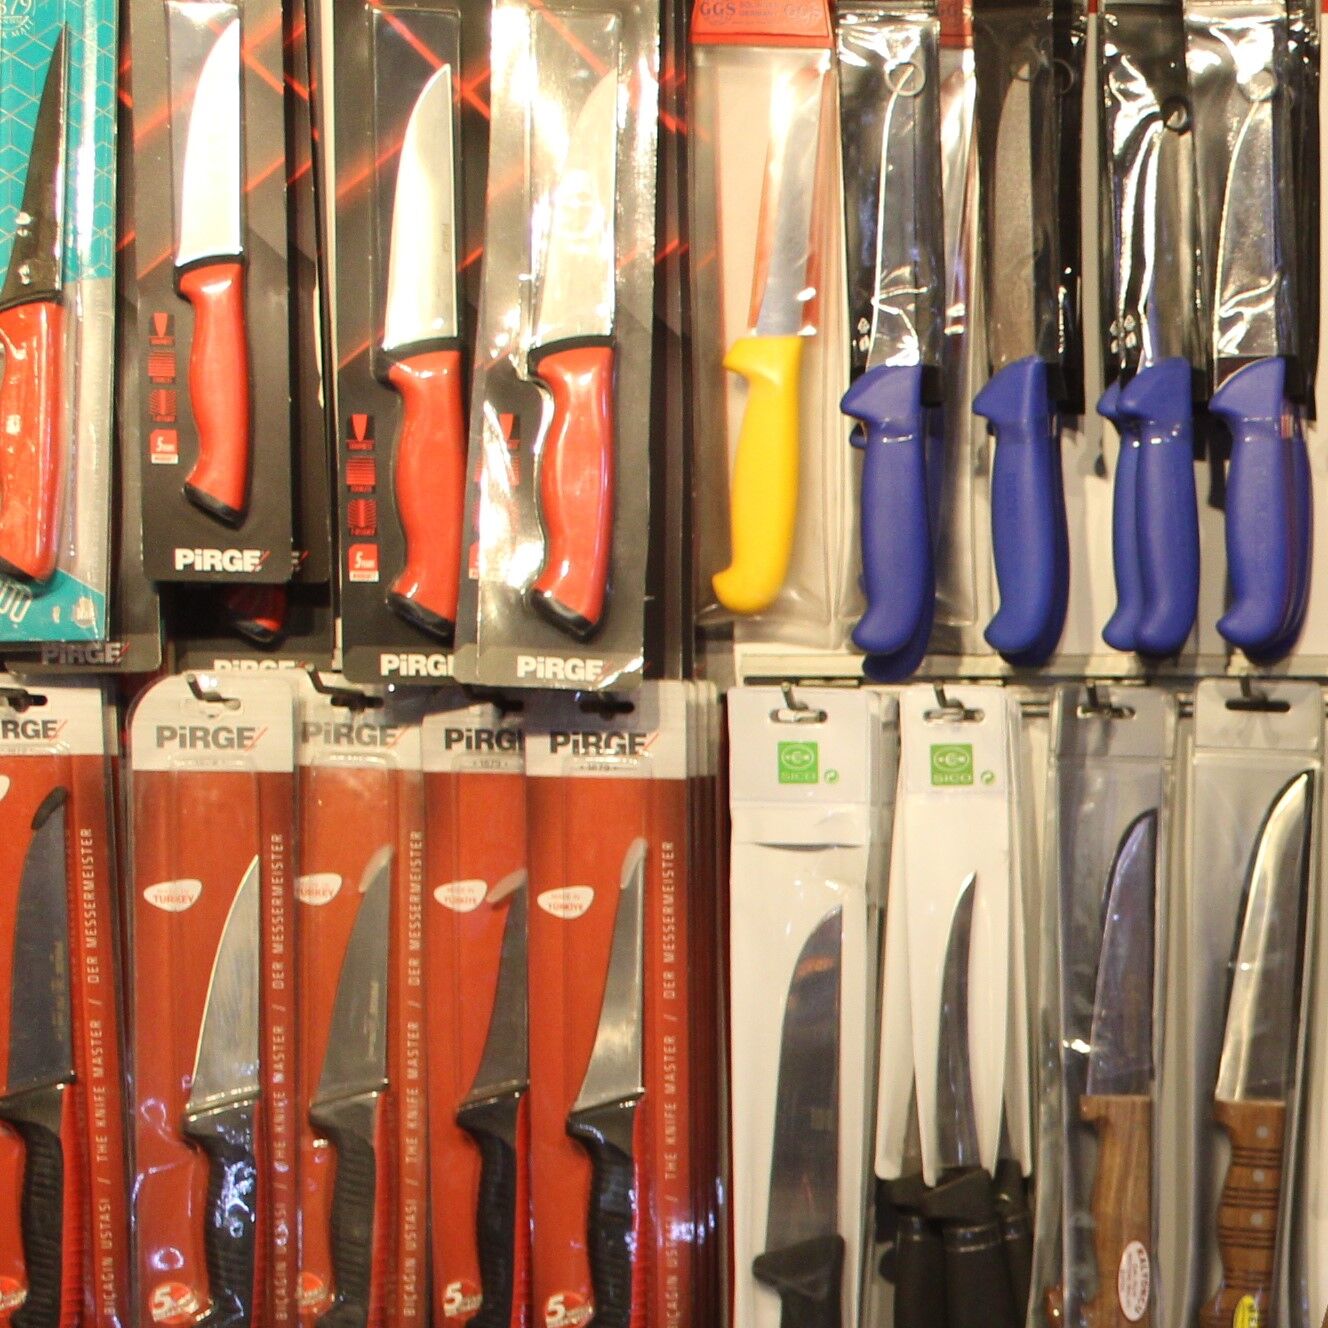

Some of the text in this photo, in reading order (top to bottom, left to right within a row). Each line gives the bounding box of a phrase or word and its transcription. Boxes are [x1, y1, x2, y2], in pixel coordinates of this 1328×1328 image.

[80, 828, 97, 949] MESSERMEISTER
[271, 833, 284, 955] MESSERMEISTER
[408, 829, 422, 952] MESSERMEISTER
[662, 840, 675, 964] MESSERMEISTER
[86, 956, 100, 985] DER
[272, 961, 285, 991] DER
[408, 957, 420, 987] DER
[663, 970, 676, 1000] DER
[89, 1020, 104, 1079] MASTER
[406, 1021, 420, 1081] MASTER
[663, 1034, 677, 1095] MASTER
[93, 1087, 106, 1128] KNIFE
[273, 1092, 286, 1134] KNIFE
[406, 1087, 419, 1131] KNIFE
[664, 1102, 677, 1146] KNIFE
[96, 1136, 108, 1162] THE
[405, 1136, 418, 1164] THE
[664, 1153, 678, 1181] THE
